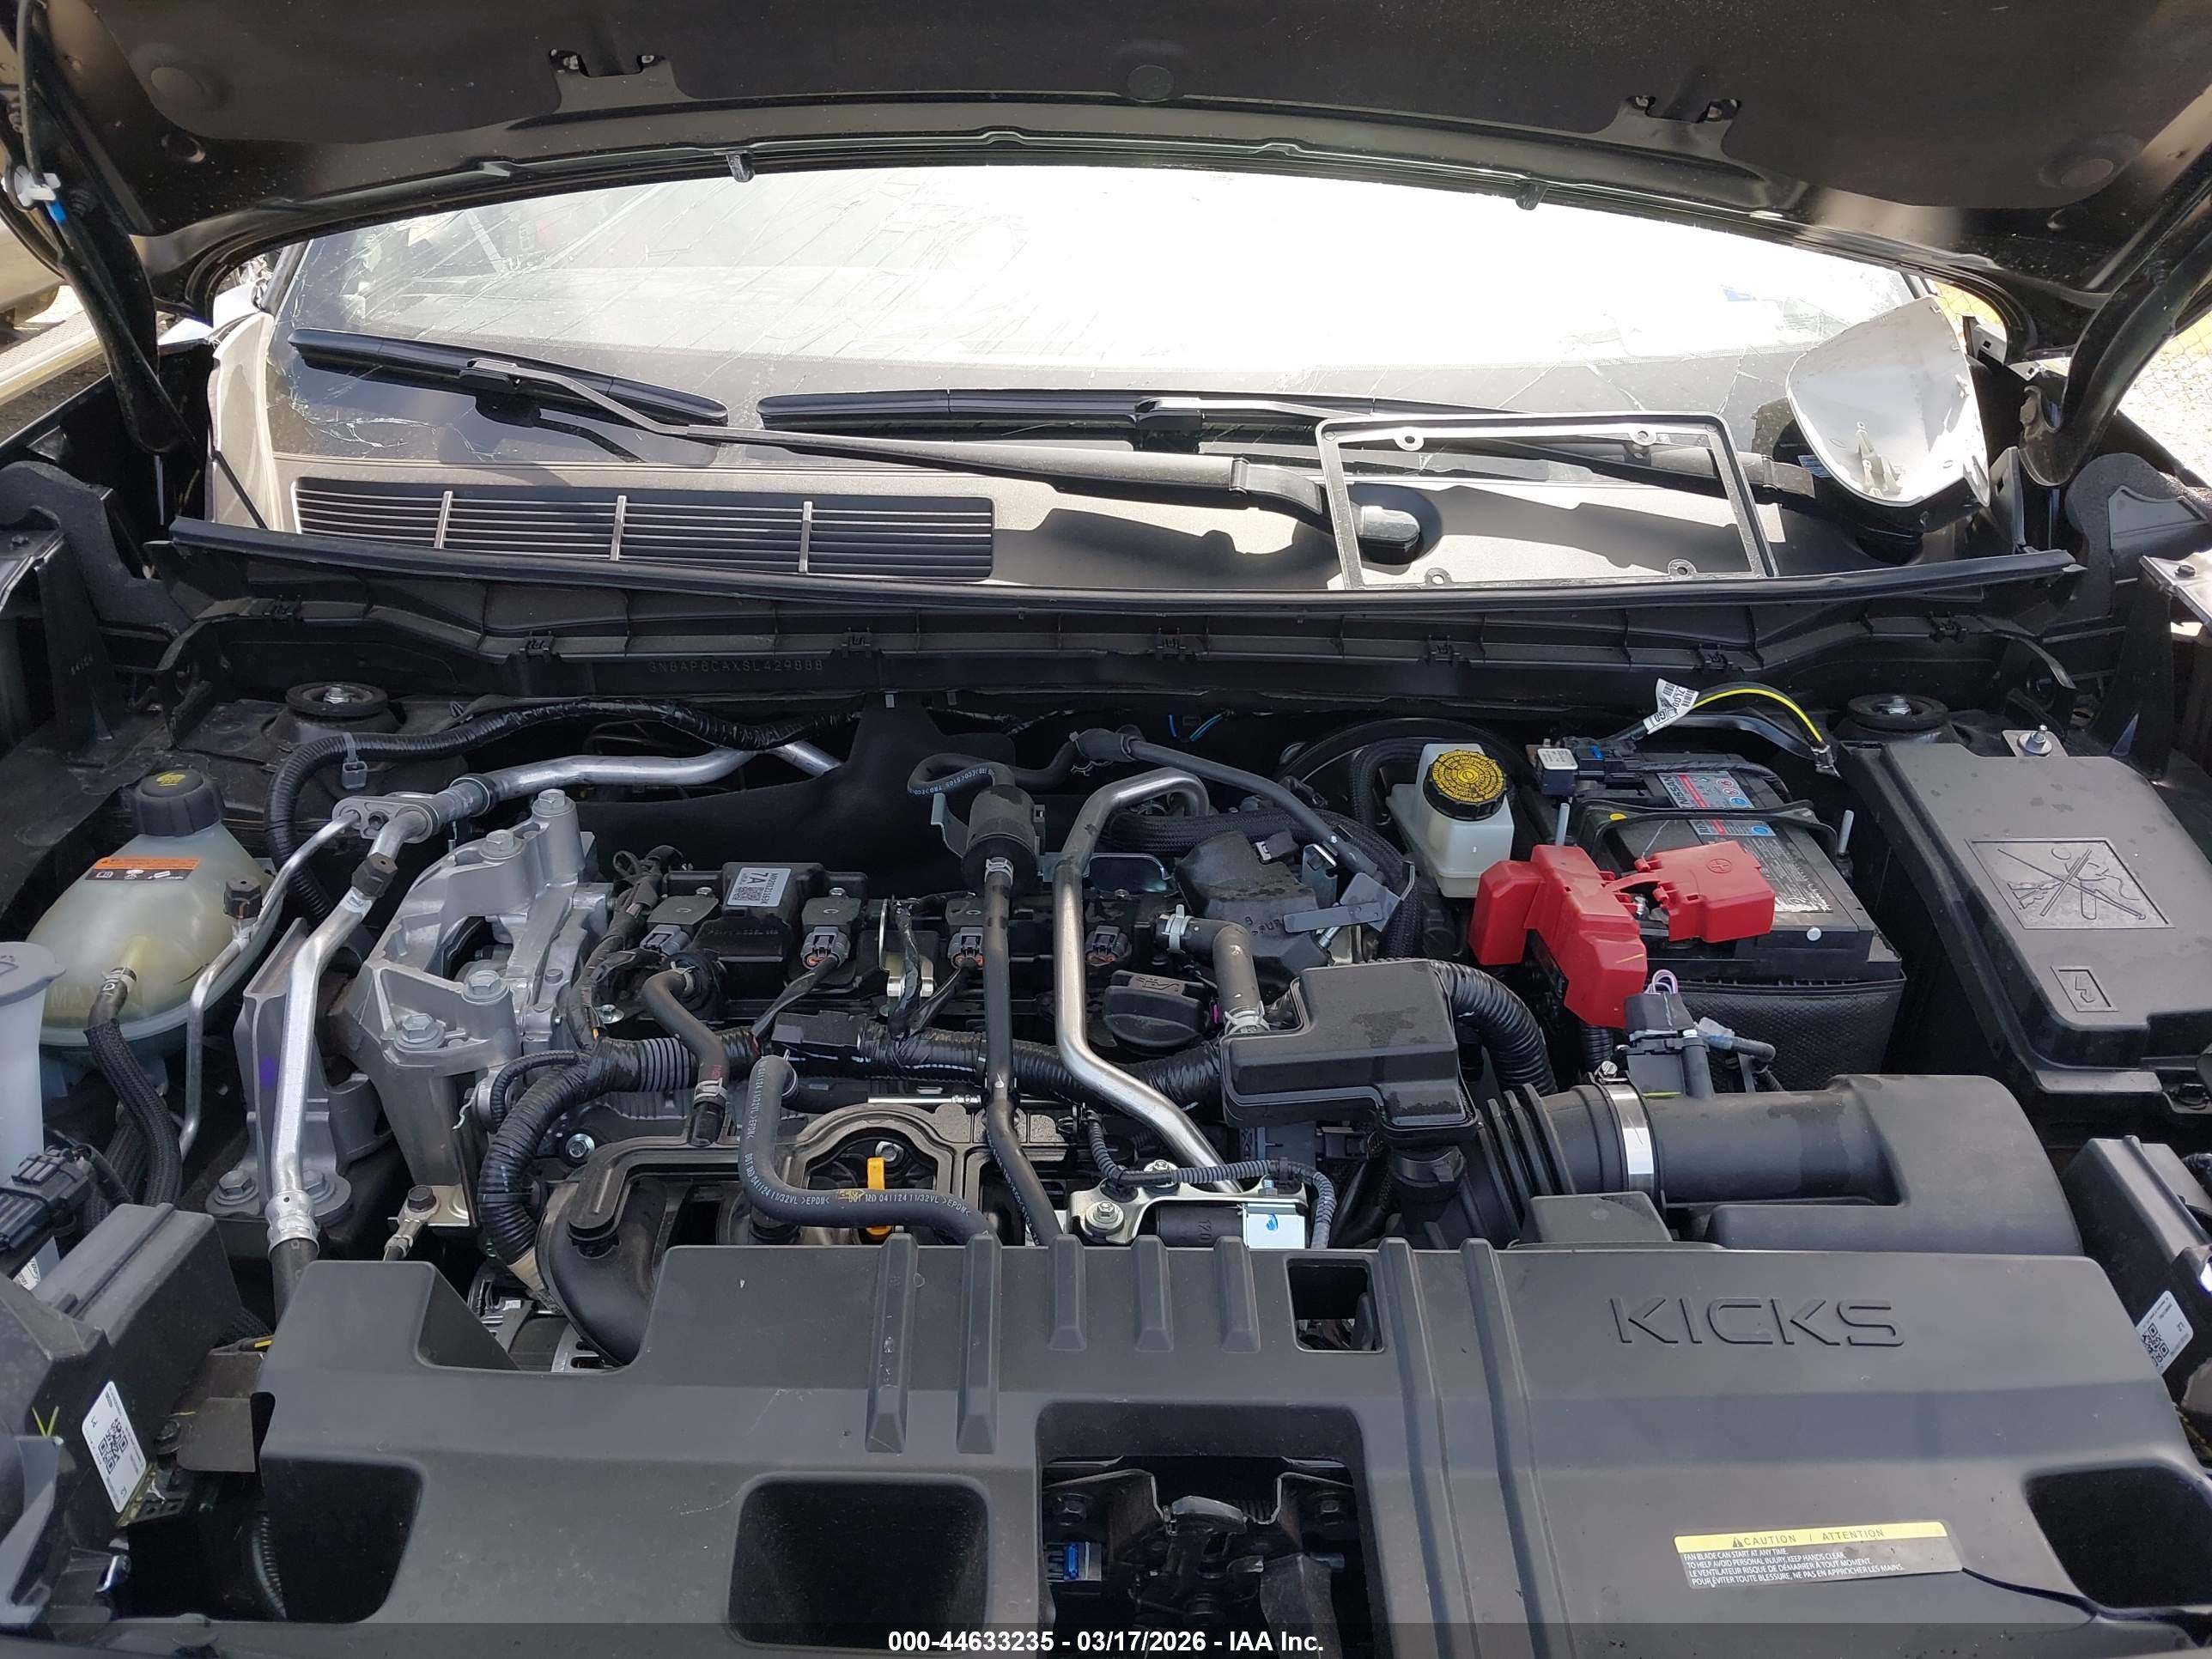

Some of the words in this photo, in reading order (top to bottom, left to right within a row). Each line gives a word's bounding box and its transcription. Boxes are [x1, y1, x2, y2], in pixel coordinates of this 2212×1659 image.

[1662, 775, 1690, 805] NISSAN
[747, 872, 769, 884] 7A
[1609, 1297, 1905, 1347] KICKS
[1743, 1534, 1797, 1547] CAUTION
[1822, 1529, 1885, 1541] ATTENTION
[1684, 1553, 1697, 1562] FAN
[1697, 1552, 1717, 1561] BLADE
[1717, 1551, 1732, 1559] CAN
[1732, 1550, 1750, 1559] START
[1759, 1548, 1772, 1557] ANY
[1687, 1561, 1697, 1570] TO
[1697, 1560, 1712, 1569] HELP
[1713, 1559, 1733, 1568] AVOID
[1733, 1557, 1765, 1566] PERSONAL
[1788, 1554, 1802, 1563] KEEP
[1802, 1553, 1826, 1561] HANDS
[1689, 1570, 1698, 1578] LE
[1697, 1567, 1741, 1577] VENTILATEUR
[1742, 1565, 1767, 1574] RISQUE
[1768, 1565, 1778, 1573] DE
[1820, 1559, 1839, 1568] TOUT
[1692, 1577, 1711, 1587] POUR
[1735, 1574, 1758, 1583] TOUTE
[1793, 1571, 1802, 1580] NE
[1802, 1571, 1817, 1579] PAS
[1817, 1570, 1827, 1578] EN
[1827, 1567, 1868, 1577] APPROCHER
[1868, 1565, 1881, 1574] LES
